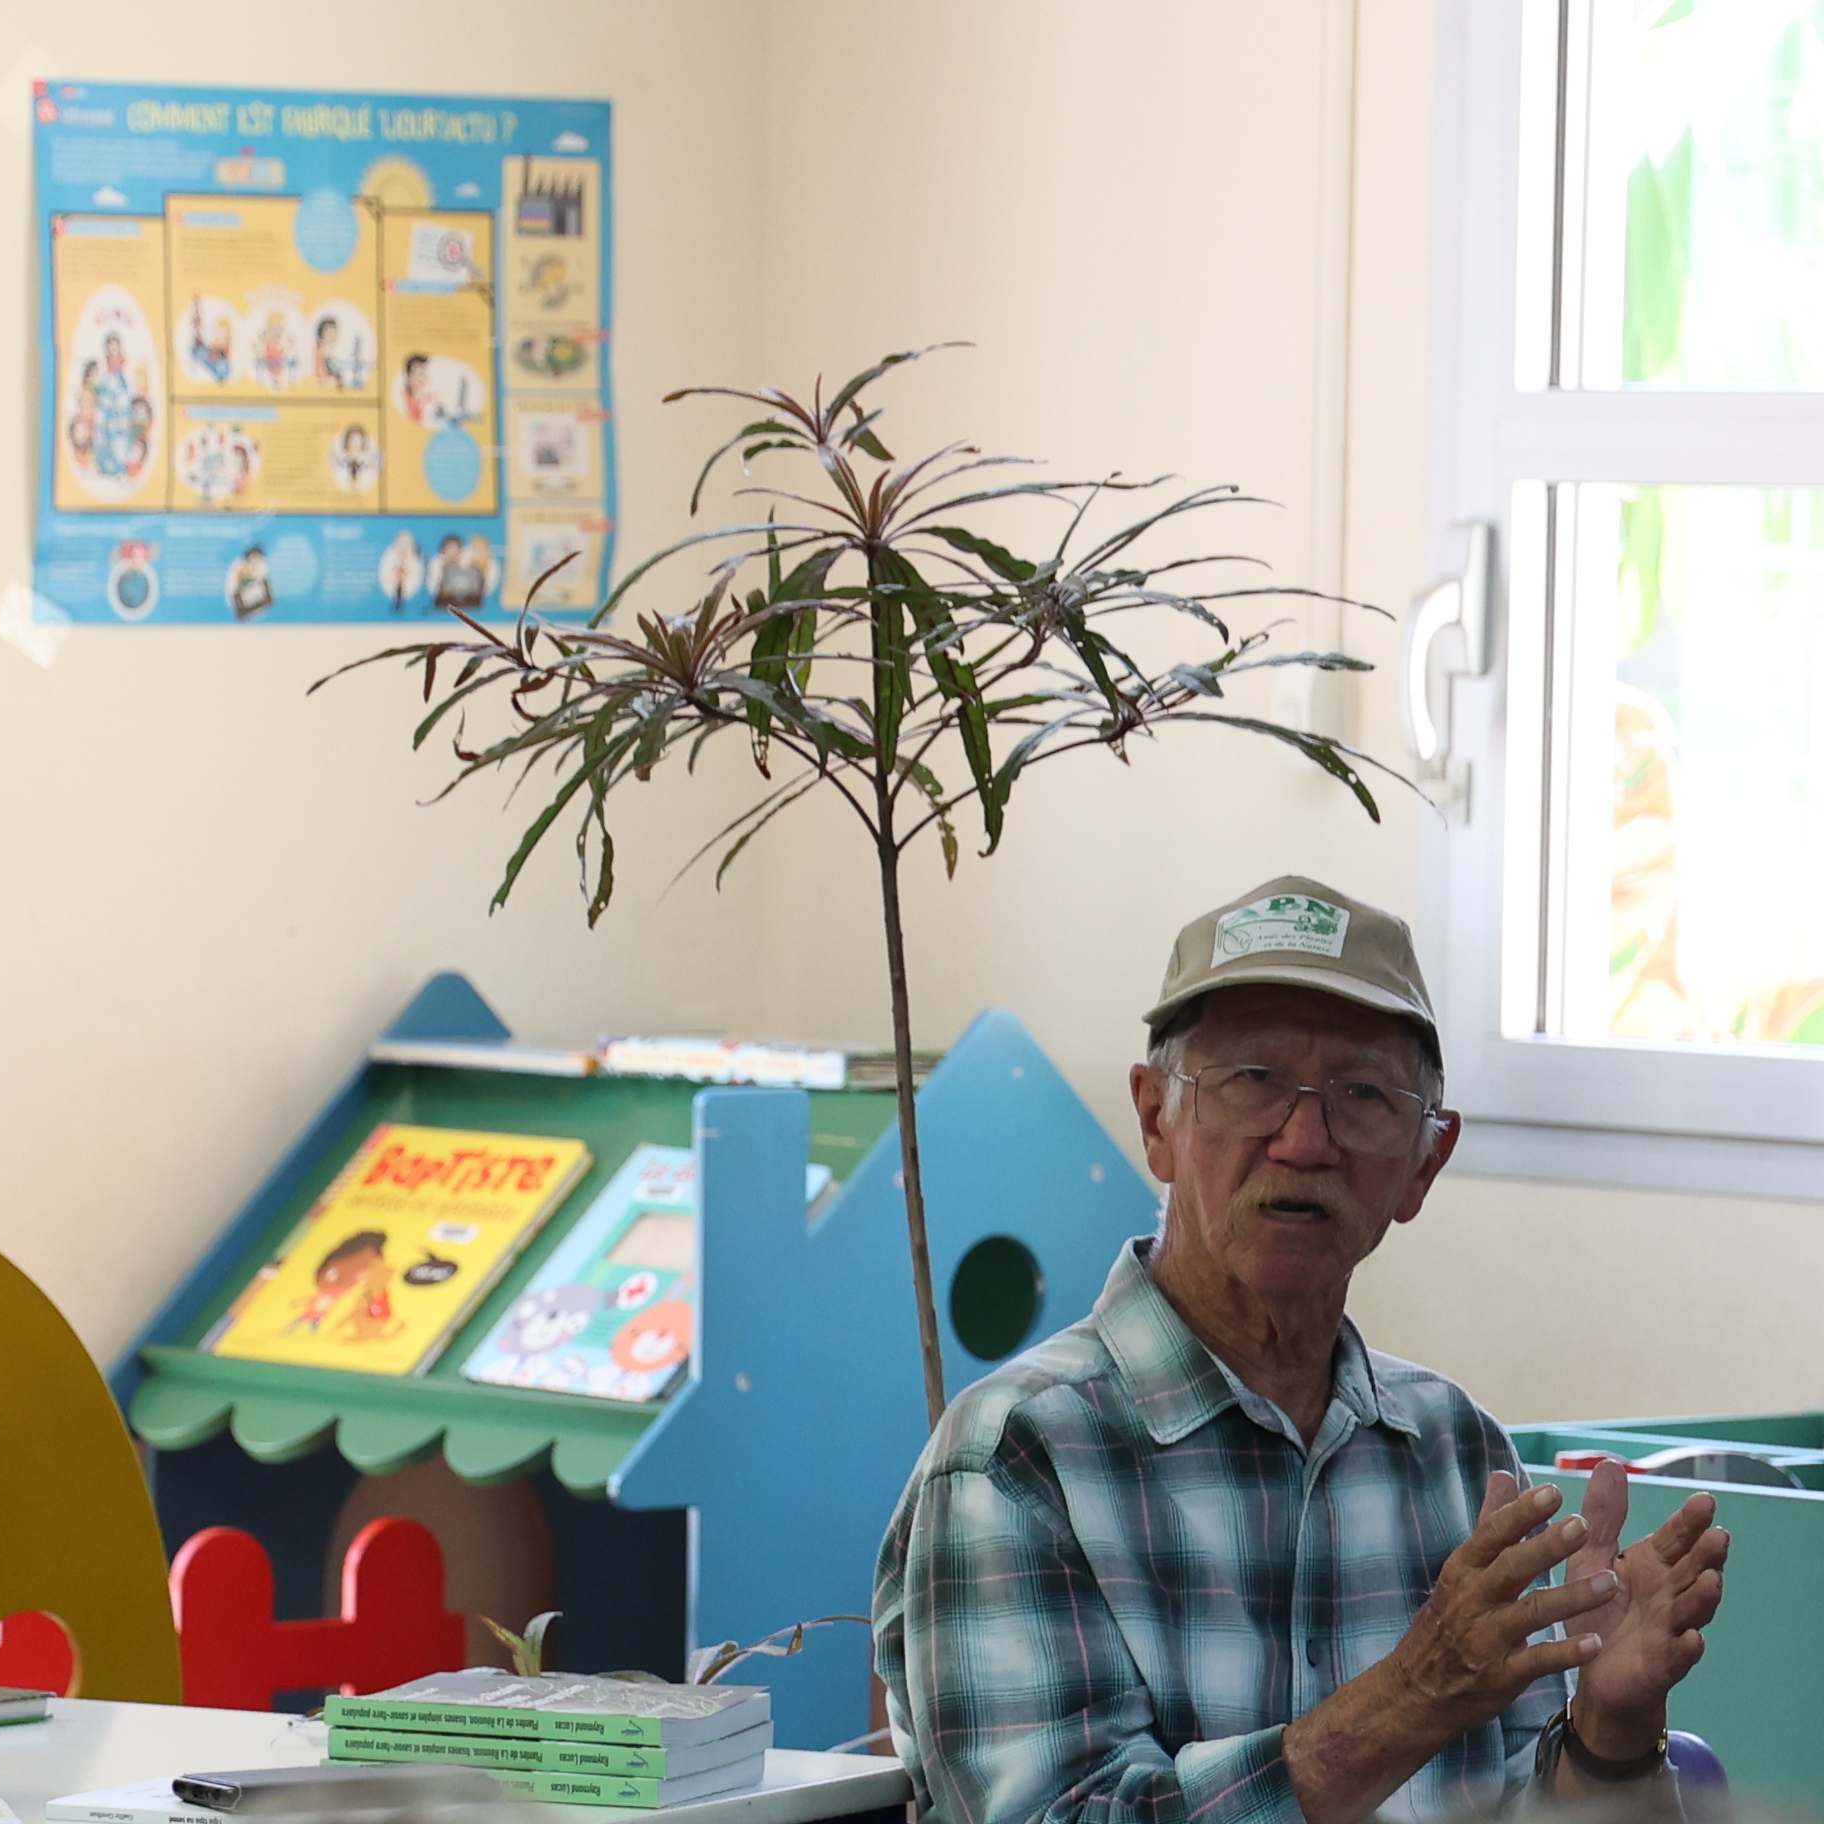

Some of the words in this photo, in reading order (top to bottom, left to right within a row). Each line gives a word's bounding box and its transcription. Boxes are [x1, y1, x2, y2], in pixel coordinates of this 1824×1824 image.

[127, 99, 231, 135] COMMENT
[236, 100, 275, 136] EST
[515, 1718, 539, 1731] Plantes
[555, 1720, 574, 1733] Lucas
[575, 1720, 604, 1736] Raymond
[520, 1751, 543, 1763] Plantes
[559, 1753, 578, 1765] Lucas
[580, 1753, 609, 1767] Raymond
[551, 1783, 570, 1795] Lucas
[571, 1783, 600, 1797] Raymond
